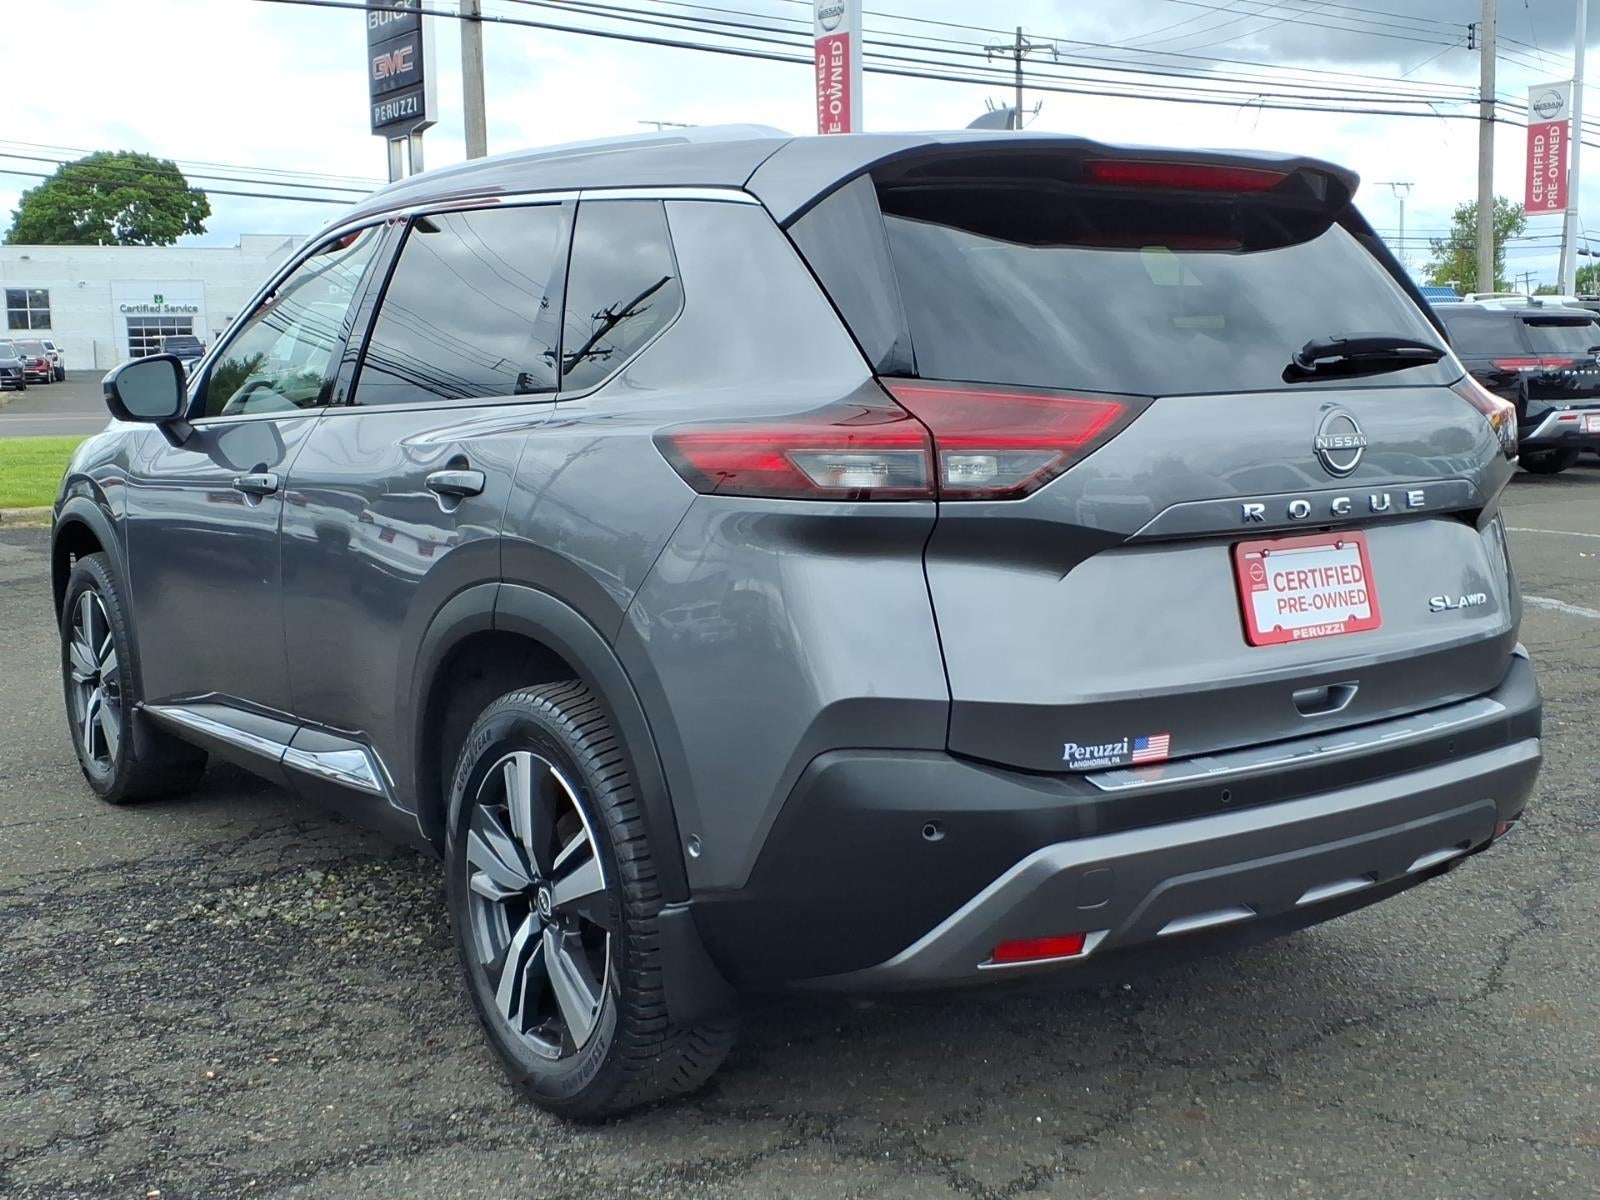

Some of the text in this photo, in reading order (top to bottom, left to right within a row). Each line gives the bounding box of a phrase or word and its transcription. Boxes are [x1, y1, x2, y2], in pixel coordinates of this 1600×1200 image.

[373, 45, 413, 80] GMC
[375, 97, 417, 122] PERUZZI
[1532, 134, 1545, 202] CERTIFIED
[1547, 126, 1560, 208] PRE-OWNED
[119, 303, 199, 314] Certified Service
[1316, 435, 1368, 450] NISSAN
[1241, 490, 1426, 523] ROGUE
[1272, 564, 1363, 592] CERTIFIED
[1276, 589, 1367, 615] PRE-OWNED
[1292, 623, 1345, 639] PERUZZI
[1062, 737, 1129, 760] Peruzzi
